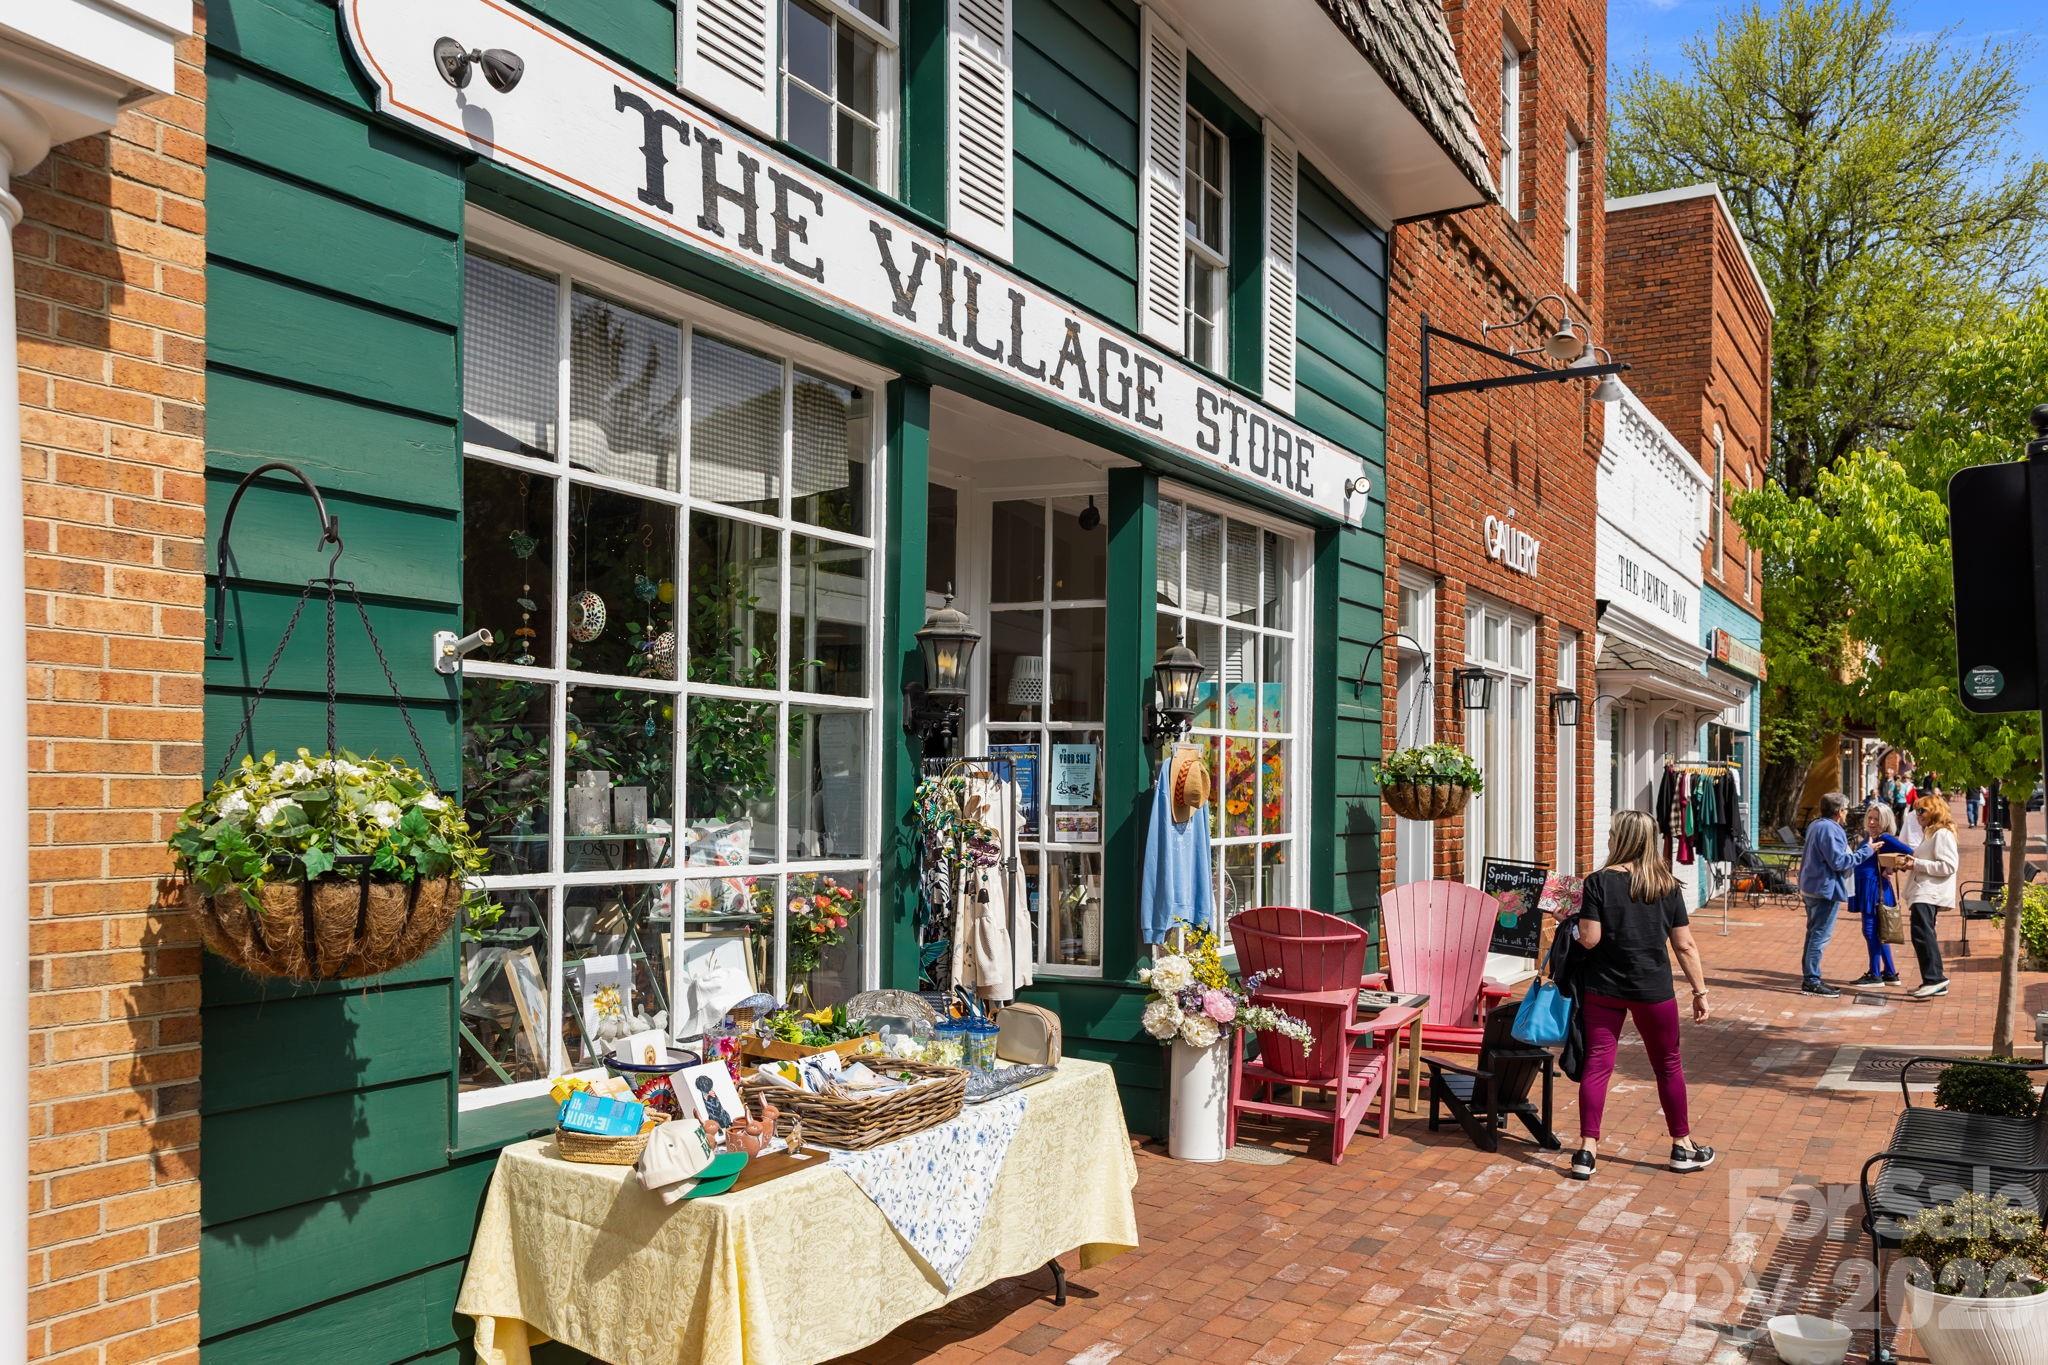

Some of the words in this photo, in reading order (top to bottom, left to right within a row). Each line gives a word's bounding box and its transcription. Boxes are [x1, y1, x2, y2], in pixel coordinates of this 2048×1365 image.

[614, 84, 824, 284] THE
[869, 219, 1164, 432] VILLAGE
[1195, 386, 1315, 498] STORE
[1484, 515, 1540, 578] GALLERY
[1619, 554, 1639, 596] THE
[1642, 570, 1671, 614] JEWEL
[1060, 753, 1075, 764] YARD
[1076, 753, 1090, 764] SALE
[566, 842, 620, 857] COSD
[566, 1110, 608, 1132] E-CLOTH
